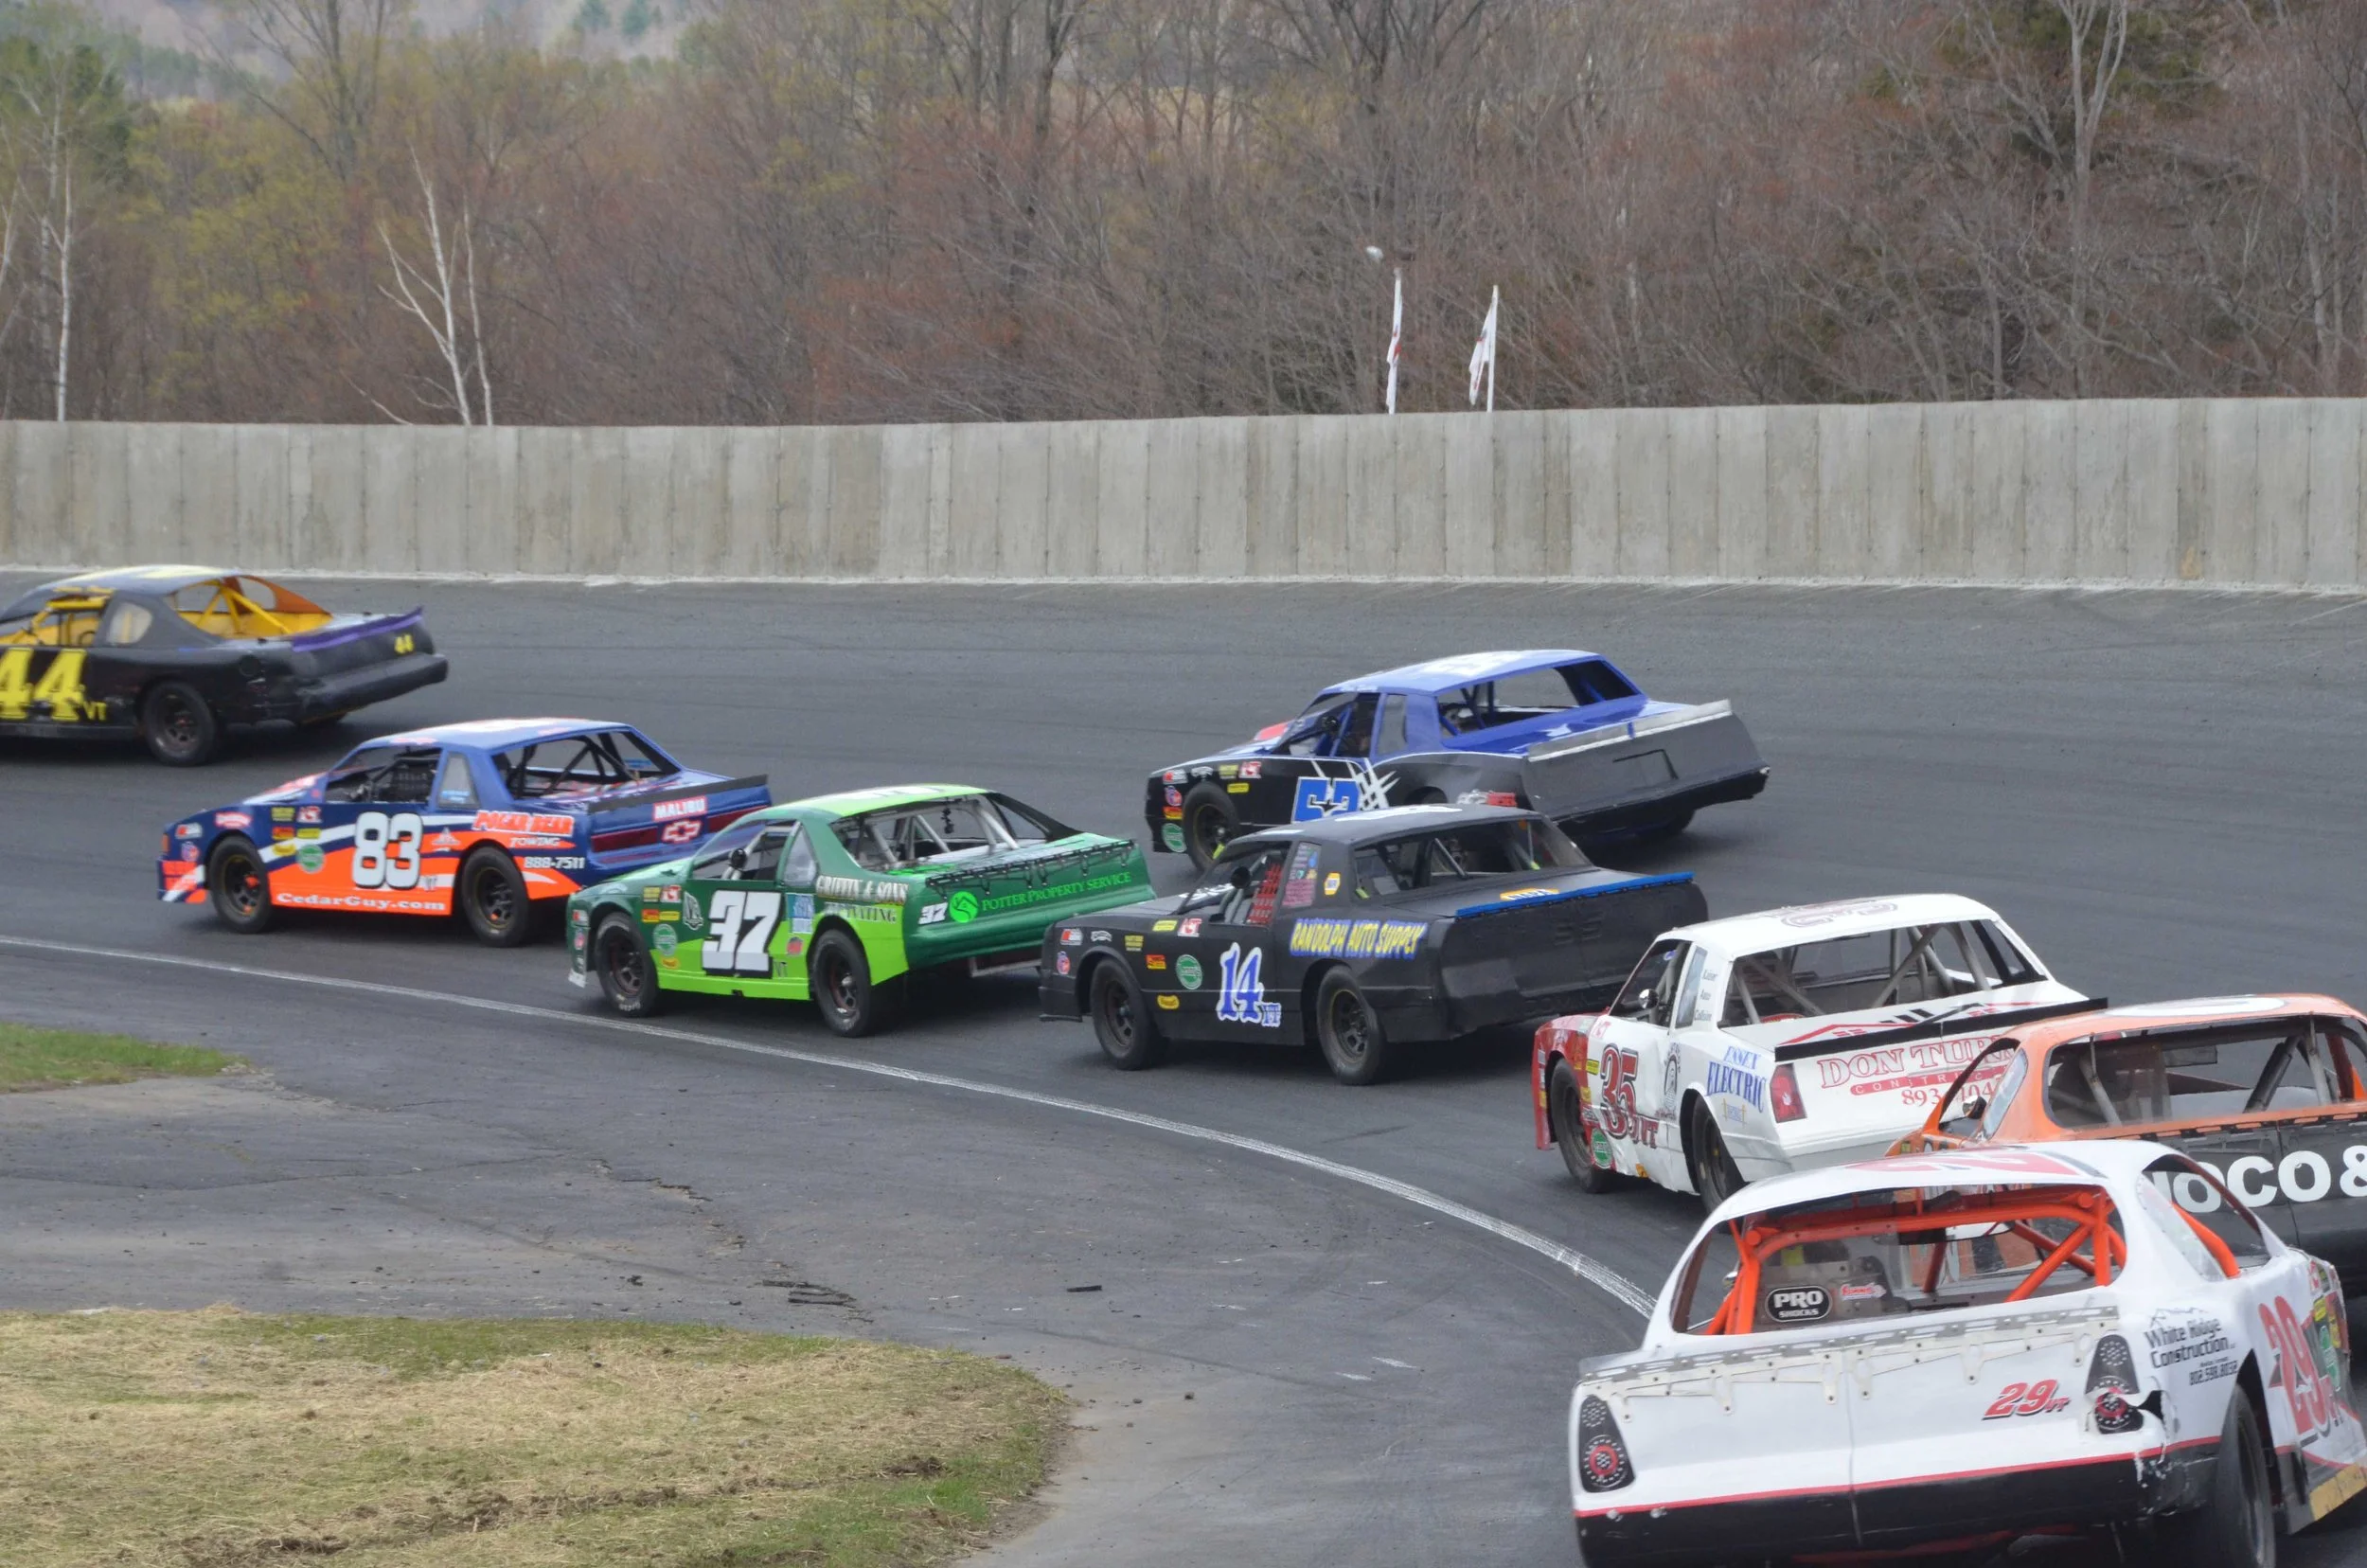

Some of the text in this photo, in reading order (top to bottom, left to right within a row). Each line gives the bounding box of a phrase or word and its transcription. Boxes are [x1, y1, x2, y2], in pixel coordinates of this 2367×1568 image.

[0, 647, 87, 722] 44
[352, 811, 424, 891] 83
[276, 892, 446, 911] CedarGuy.com
[981, 871, 1132, 911] POTTER PROPERTY SERVICE
[702, 889, 782, 975] 37
[917, 902, 948, 925] 37
[1290, 918, 1428, 961] RANDOLPH AUTO SUPPLY
[1216, 941, 1265, 1024] 14
[1706, 1060, 1768, 1114] ELECTRIC
[1817, 1047, 1904, 1089] DON
[1600, 1042, 1638, 1140] 35
[1773, 1291, 1824, 1308] PRO
[1779, 1308, 1819, 1318] SHOCKS
[2150, 1336, 2230, 1368] Construction
[1983, 1379, 2058, 1420] 29
